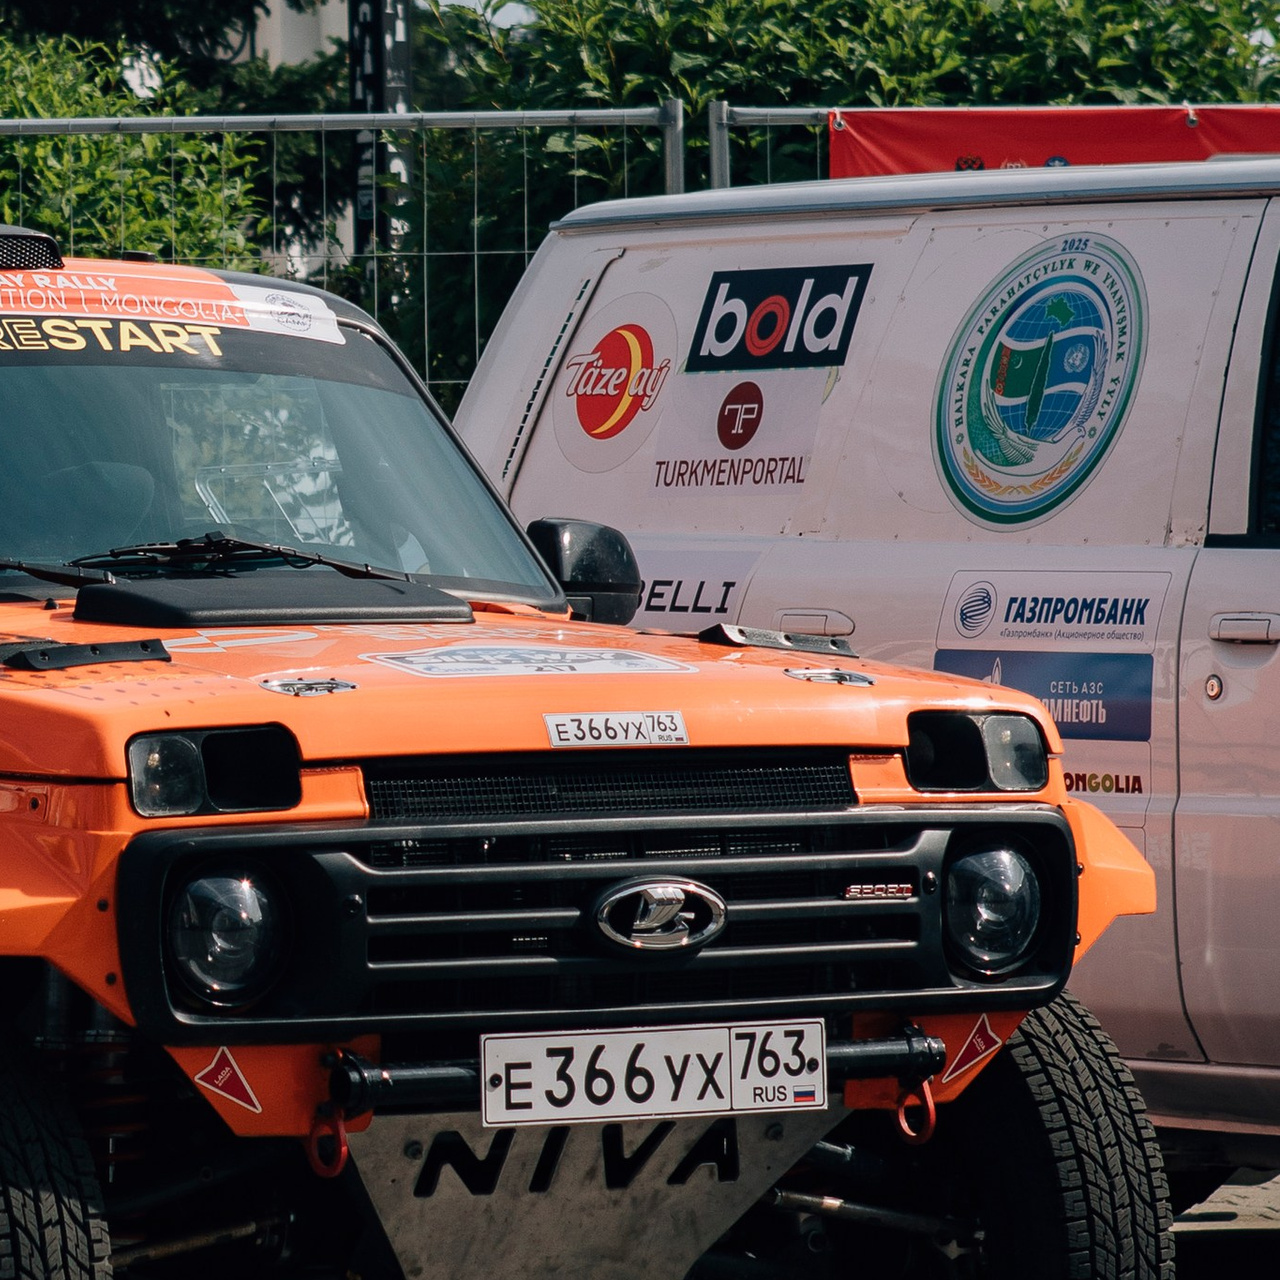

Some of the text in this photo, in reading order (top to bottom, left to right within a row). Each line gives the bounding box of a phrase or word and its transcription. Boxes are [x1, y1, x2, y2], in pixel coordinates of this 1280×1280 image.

[1061, 238, 1090, 252] 2025
[33, 274, 117, 292] RALLY
[100, 293, 241, 323] MONGOLIA
[699, 276, 859, 357] bold
[955, 346, 976, 428] HALKARA
[1083, 259, 1101, 276] WE
[566, 351, 622, 398] Täze
[654, 456, 806, 488] TURKMENPORTAL
[1004, 596, 1151, 626] ГАЗПРОМБАНК
[1050, 681, 1104, 695] СЕТЬ АЗС
[646, 715, 678, 733] 763
[658, 734, 673, 742] RUS
[1063, 771, 1143, 794] ONGOLIA
[735, 1029, 806, 1080] 763
[753, 1084, 788, 1104] RUS
[412, 1118, 741, 1198] NIVA
